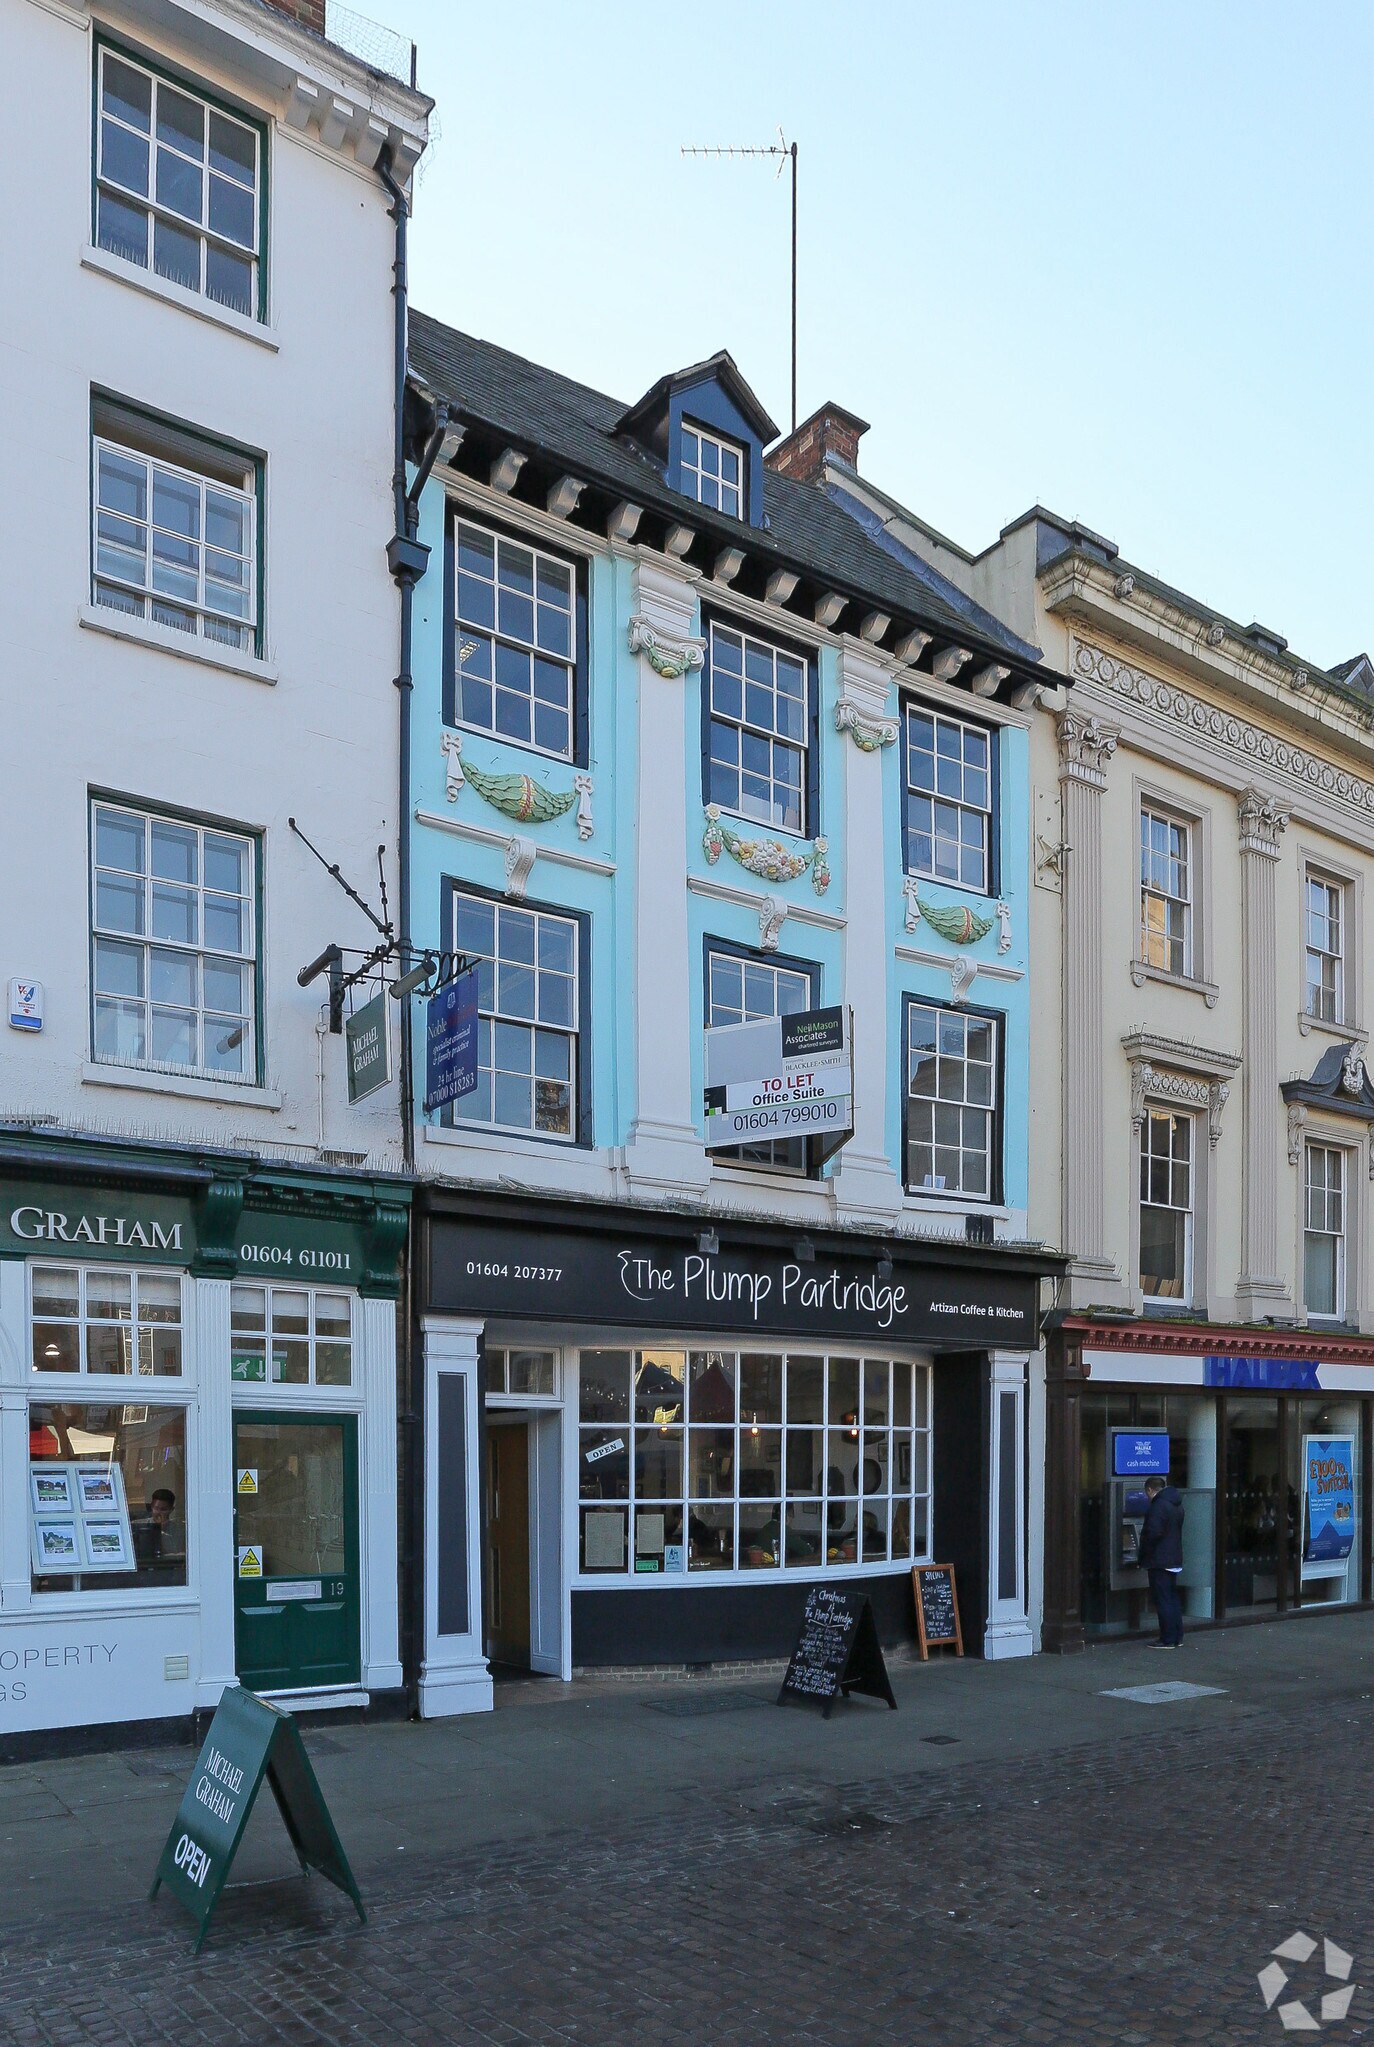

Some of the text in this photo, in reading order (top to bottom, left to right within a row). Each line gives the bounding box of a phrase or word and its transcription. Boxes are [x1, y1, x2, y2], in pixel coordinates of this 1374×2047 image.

[428, 1018, 447, 1038] Noble
[785, 1031, 827, 1045] Associates
[353, 1026, 379, 1056] MICHAEL
[353, 1044, 379, 1073] GRAHAM
[762, 1073, 815, 1092] TO LET
[752, 1086, 825, 1106] Office Suite
[733, 1102, 837, 1131] 01604 799010
[10, 1206, 183, 1250] GRAHAM
[241, 1244, 351, 1270] 01604 611011
[466, 1261, 562, 1281] 01604 207377
[632, 1255, 908, 1327] The Plump Partridge
[930, 1301, 1024, 1318] Artizan Coffee & Kitchen
[592, 1443, 617, 1458] OPEN
[1310, 1457, 1337, 1479] £100
[925, 1571, 944, 1581] SPECIALS
[331, 1582, 344, 1596] 19
[819, 1590, 846, 1603] Christmas
[204, 1747, 244, 1795] MICHAEL
[195, 1775, 235, 1824] GRAHAM
[174, 1834, 212, 1888] OPEN
